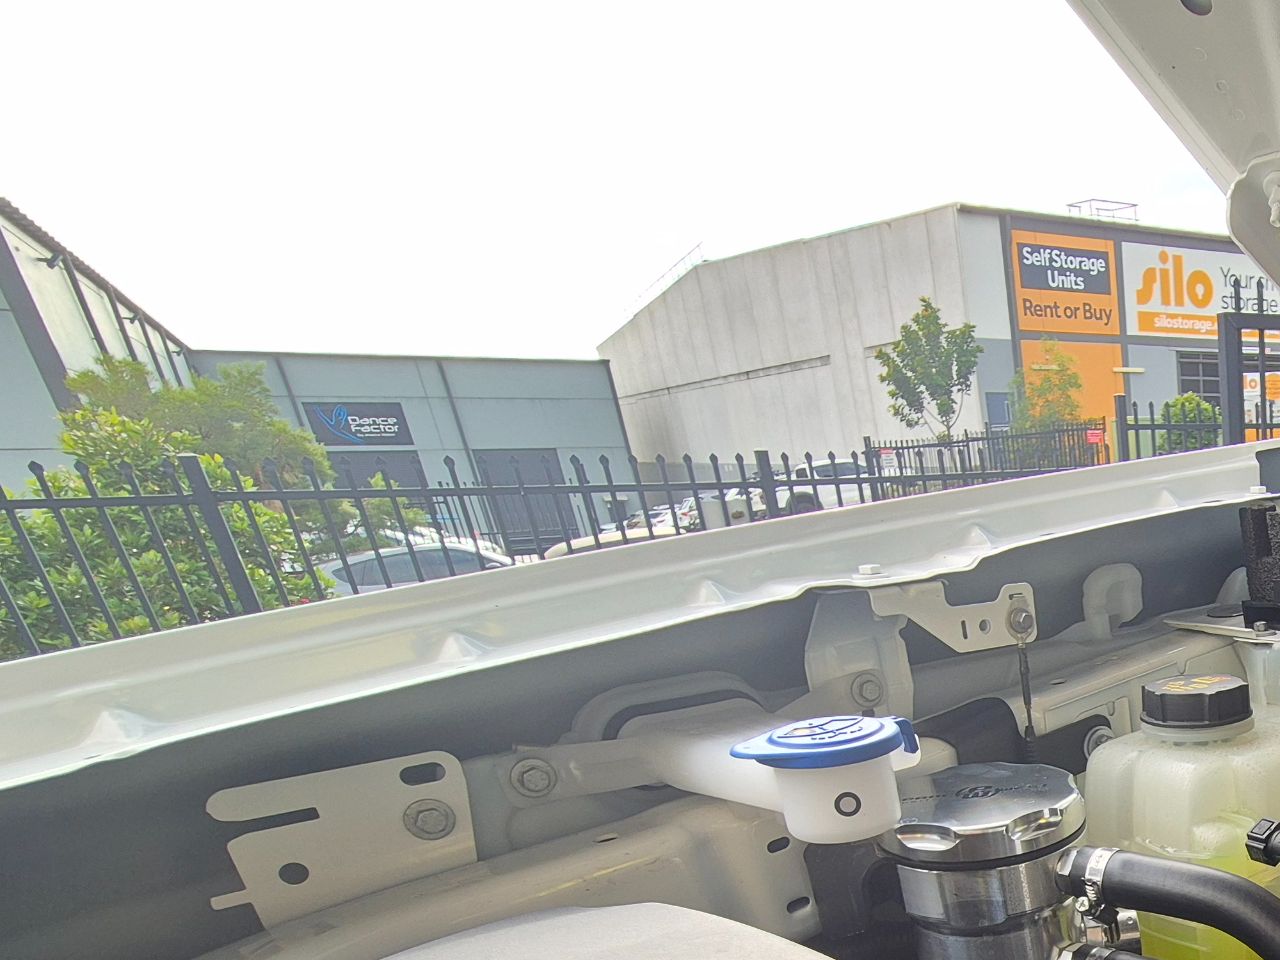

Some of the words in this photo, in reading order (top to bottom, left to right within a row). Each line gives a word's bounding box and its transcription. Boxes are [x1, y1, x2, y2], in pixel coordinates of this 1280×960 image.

[1022, 246, 1051, 267] Self
[1051, 249, 1106, 275] Storage
[1047, 269, 1085, 290] Units
[1136, 250, 1213, 309] silo
[1022, 298, 1061, 318] Rent
[1063, 305, 1080, 319] or
[1082, 302, 1112, 326] Buy
[347, 416, 397, 425] Dance
